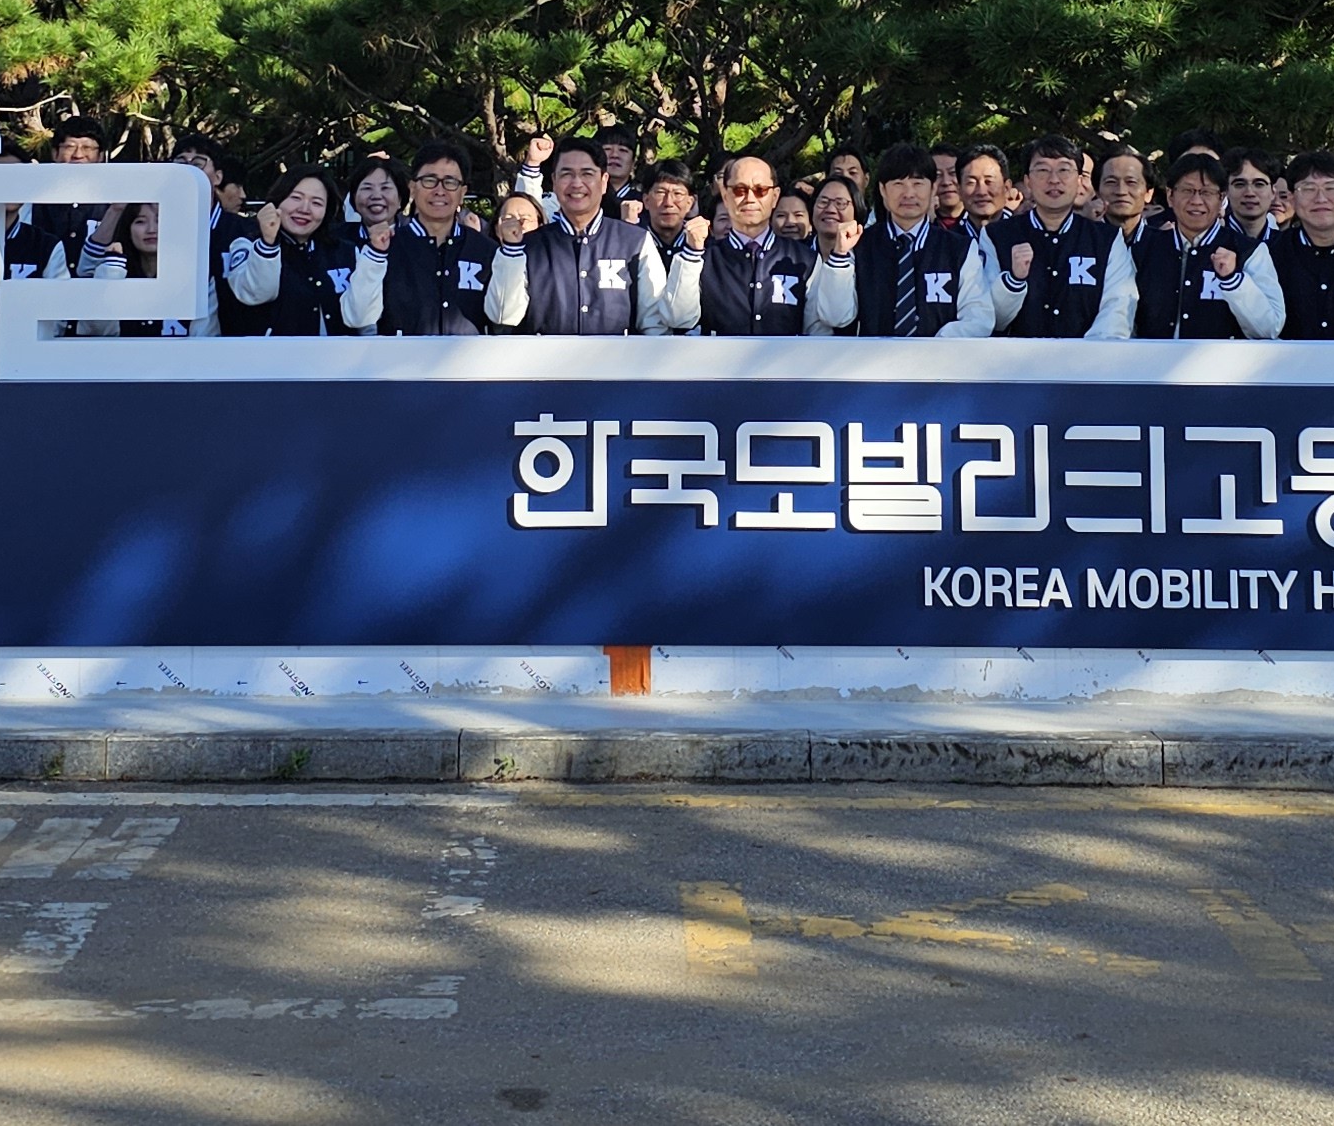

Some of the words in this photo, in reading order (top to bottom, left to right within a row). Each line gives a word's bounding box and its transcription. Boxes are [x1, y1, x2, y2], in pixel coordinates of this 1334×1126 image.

[327, 267, 351, 294] K
[458, 260, 484, 291] K
[597, 259, 627, 290] K
[1069, 256, 1096, 286] K
[1200, 270, 1224, 300] K
[771, 274, 799, 305] K
[924, 272, 952, 303] K
[923, 566, 1073, 609] KOREA
[1086, 568, 1299, 611] MOBILITY
